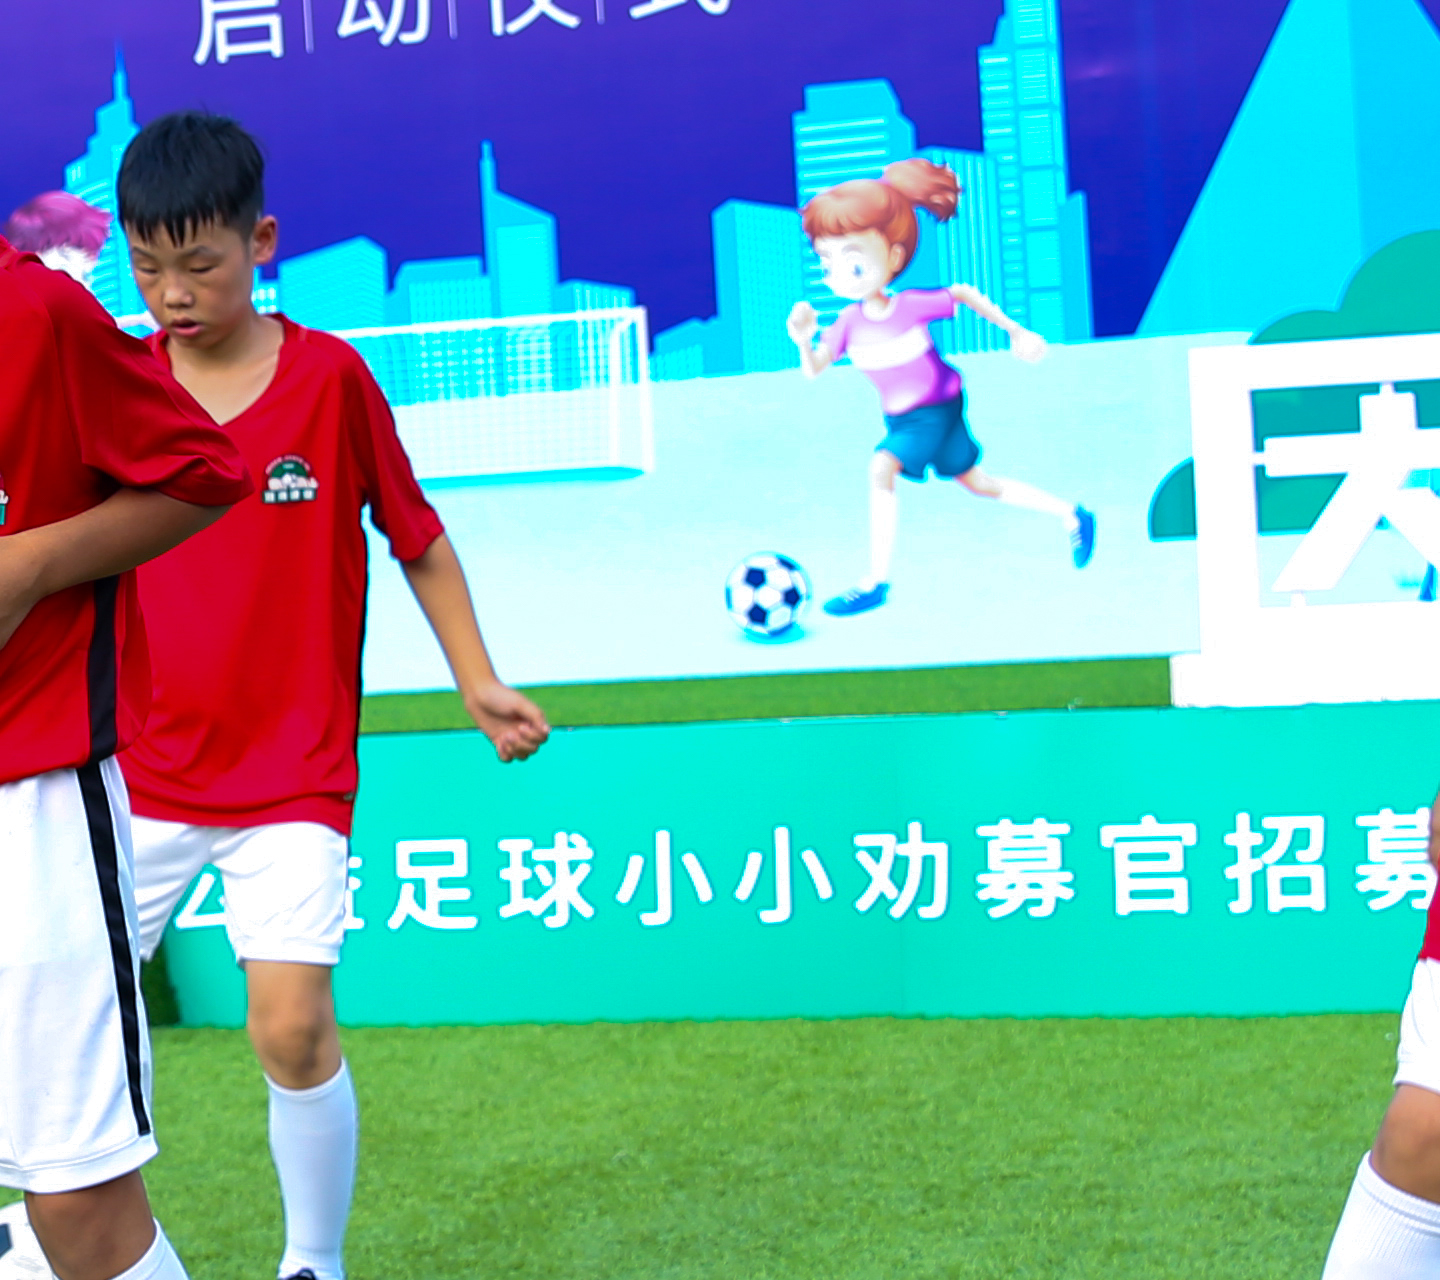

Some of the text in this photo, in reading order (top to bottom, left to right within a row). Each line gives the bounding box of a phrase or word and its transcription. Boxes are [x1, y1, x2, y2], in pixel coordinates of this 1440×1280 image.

[174, 806, 1439, 932] 足球小小劝募官招募
